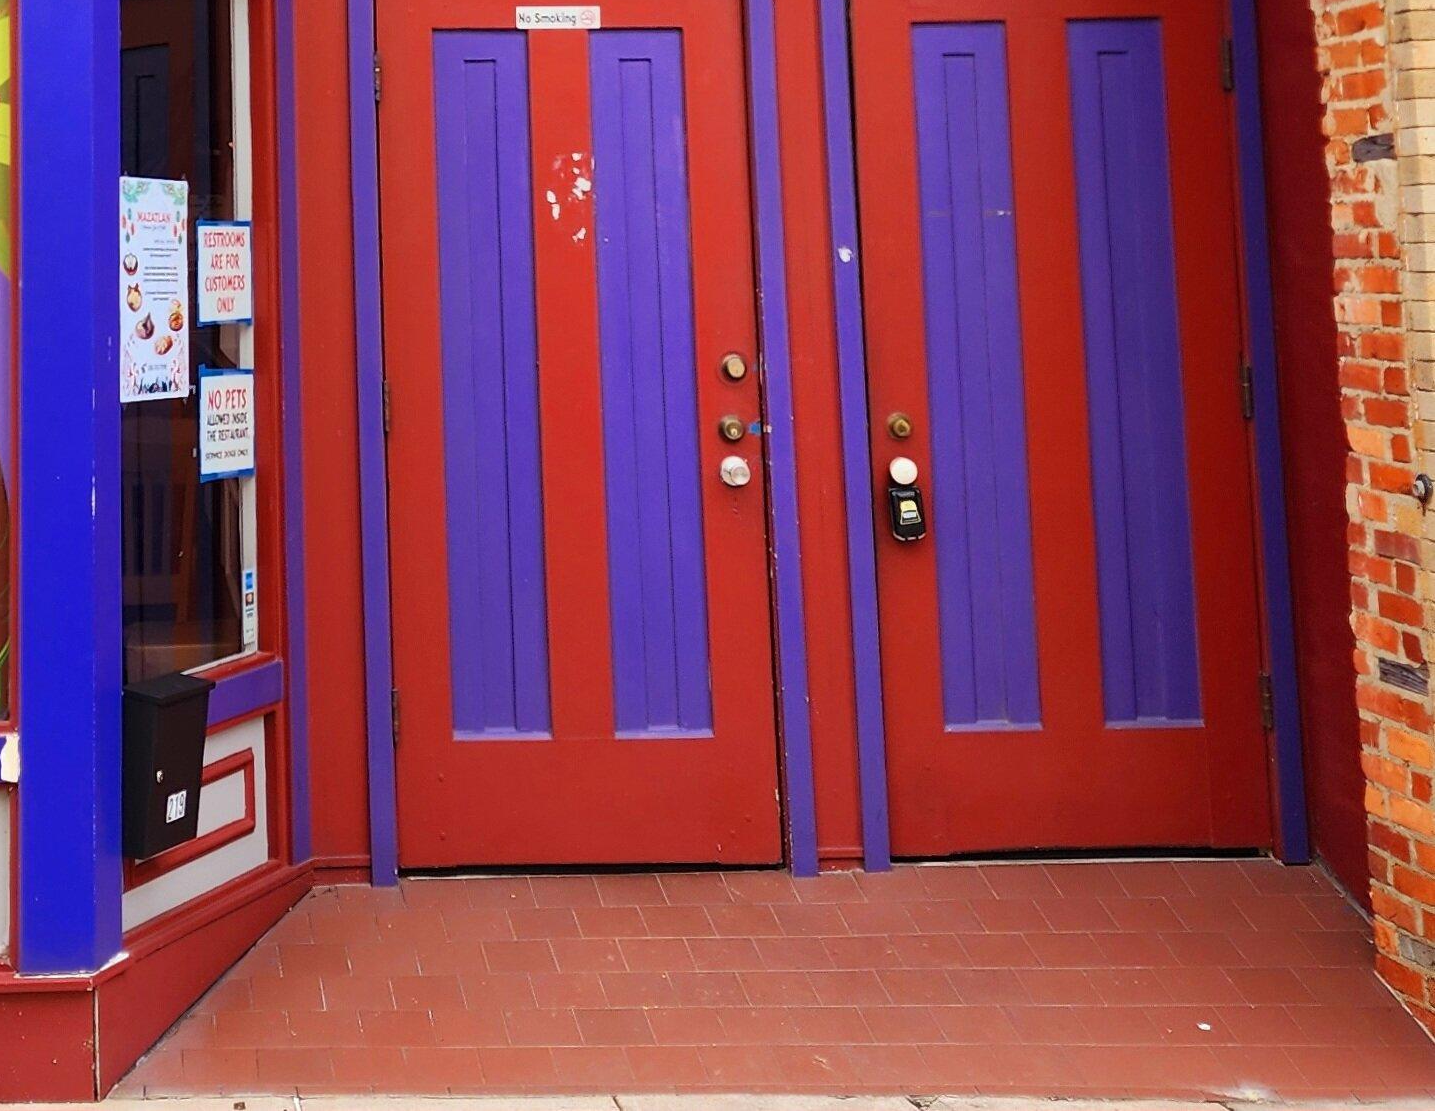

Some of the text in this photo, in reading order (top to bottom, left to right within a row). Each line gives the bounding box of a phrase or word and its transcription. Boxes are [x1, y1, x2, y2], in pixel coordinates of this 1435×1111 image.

[519, 12, 577, 26] No Smoking
[204, 232, 245, 248] RESTROOMS
[211, 253, 240, 270] ARE FOR
[205, 275, 245, 292] CUSTOMERS
[217, 297, 235, 313] ONLY
[207, 388, 247, 410] NO PETS
[167, 794, 184, 820] 219
